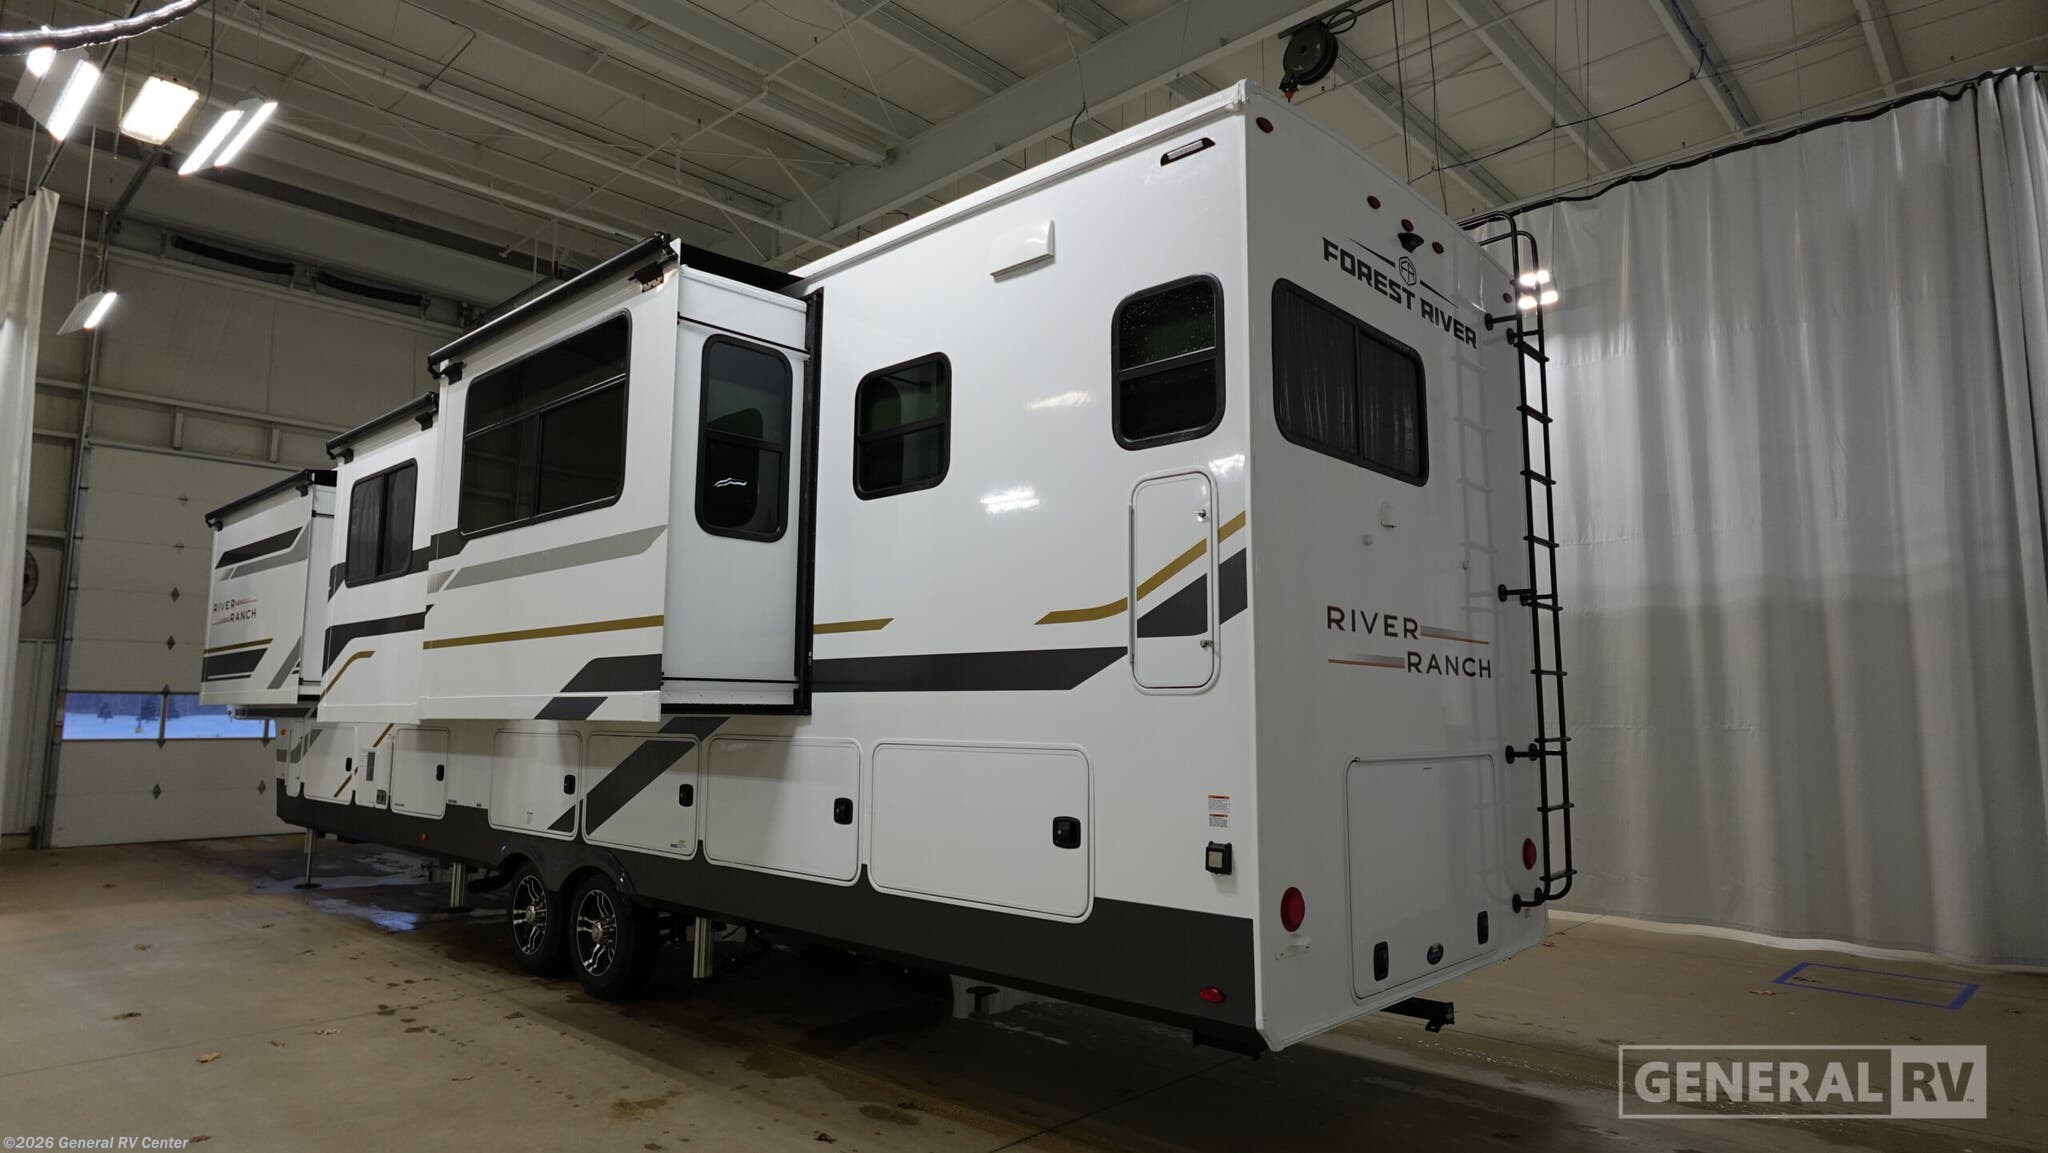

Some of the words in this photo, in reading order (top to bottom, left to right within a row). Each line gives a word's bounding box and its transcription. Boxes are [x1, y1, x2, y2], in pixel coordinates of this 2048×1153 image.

[1322, 237, 1416, 310] FOREST
[1420, 297, 1478, 349] RIVER
[213, 599, 236, 611] RIVER
[230, 608, 257, 621] RANCH
[1327, 605, 1419, 640] RIVER
[1407, 651, 1492, 679] RANCH
